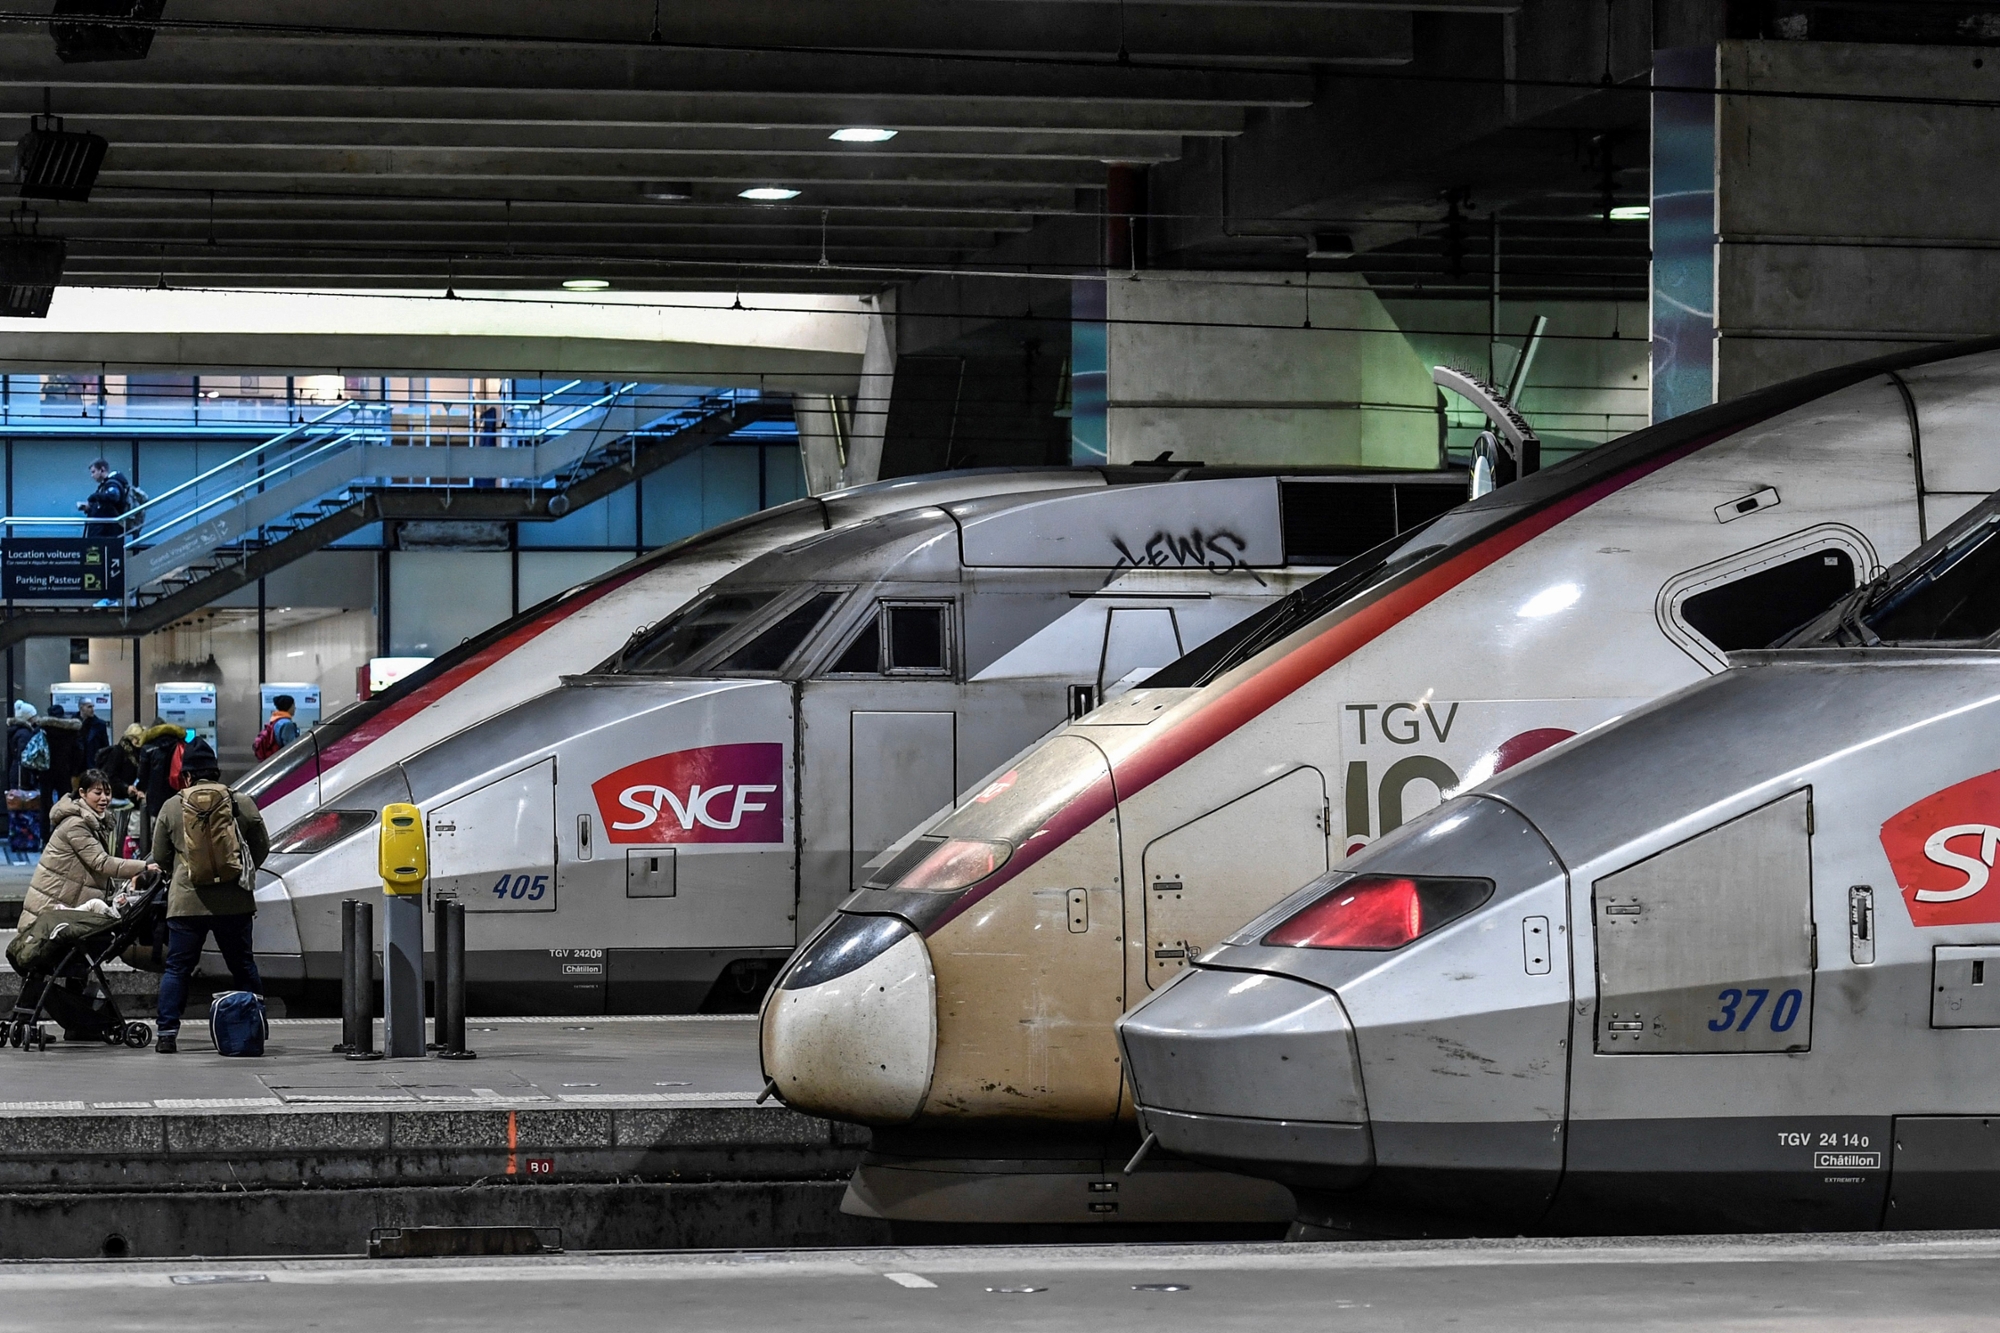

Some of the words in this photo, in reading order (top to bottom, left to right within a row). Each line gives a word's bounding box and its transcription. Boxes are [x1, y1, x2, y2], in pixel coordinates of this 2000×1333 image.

[8, 550, 45, 559] Location
[46, 550, 81, 559] voitures
[15, 575, 47, 585] Parking
[48, 575, 81, 585] Pasteur
[1345, 702, 1459, 744] TGV
[611, 784, 777, 831] SNCF
[1915, 824, 2000, 903] S
[493, 873, 549, 901] 405
[549, 949, 569, 958] TGV
[574, 949, 602, 959] 24209
[1708, 988, 1803, 1033] 370
[1778, 1132, 1811, 1146] TGV
[1820, 1155, 1874, 1166] Châtillon
